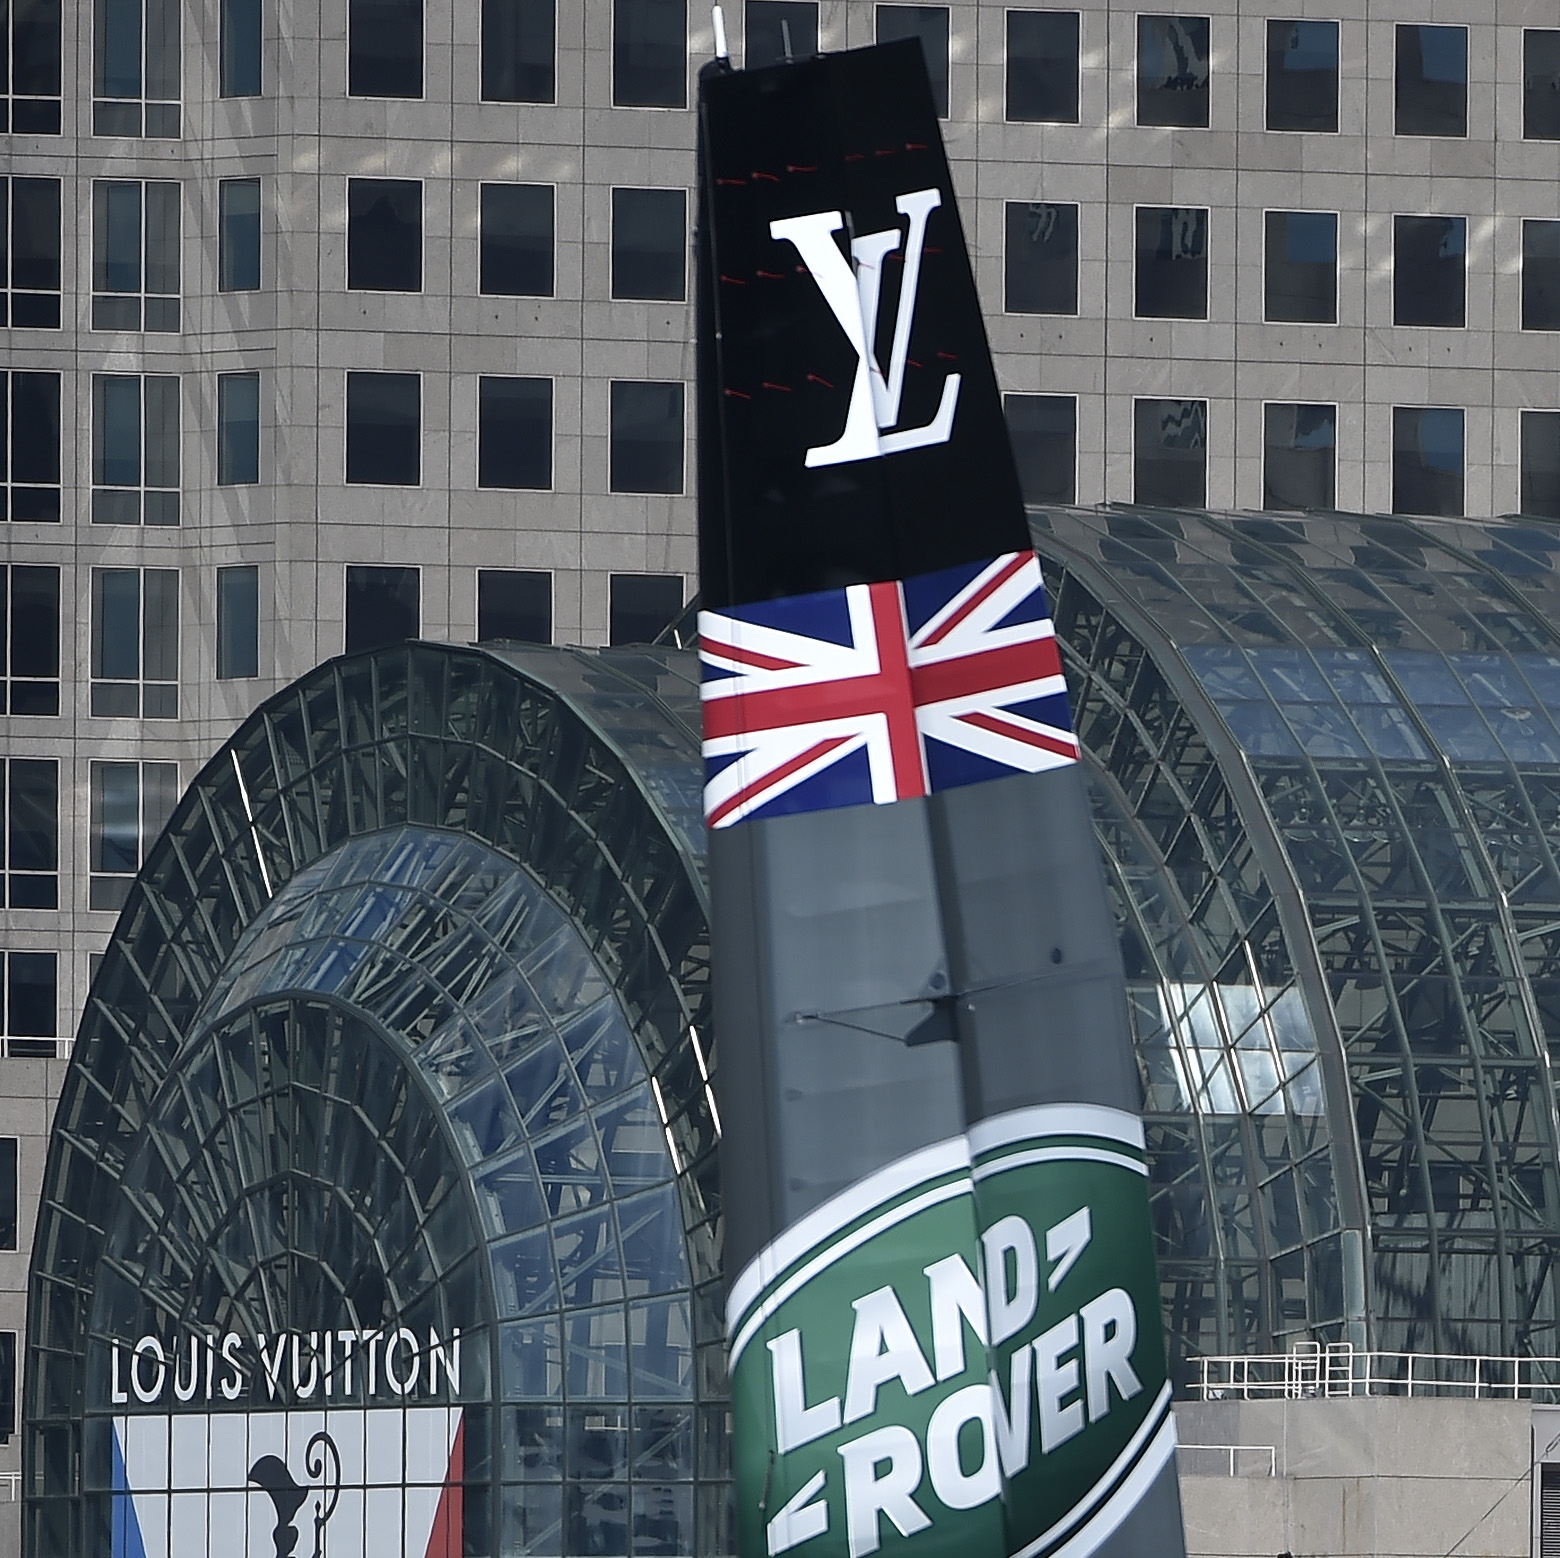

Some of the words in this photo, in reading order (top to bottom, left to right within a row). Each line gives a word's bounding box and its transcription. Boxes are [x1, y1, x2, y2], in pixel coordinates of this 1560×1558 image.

[111, 1331, 242, 1403] LOUIS
[257, 1327, 461, 1401] VUITTON
[766, 1215, 1039, 1454] LAND
